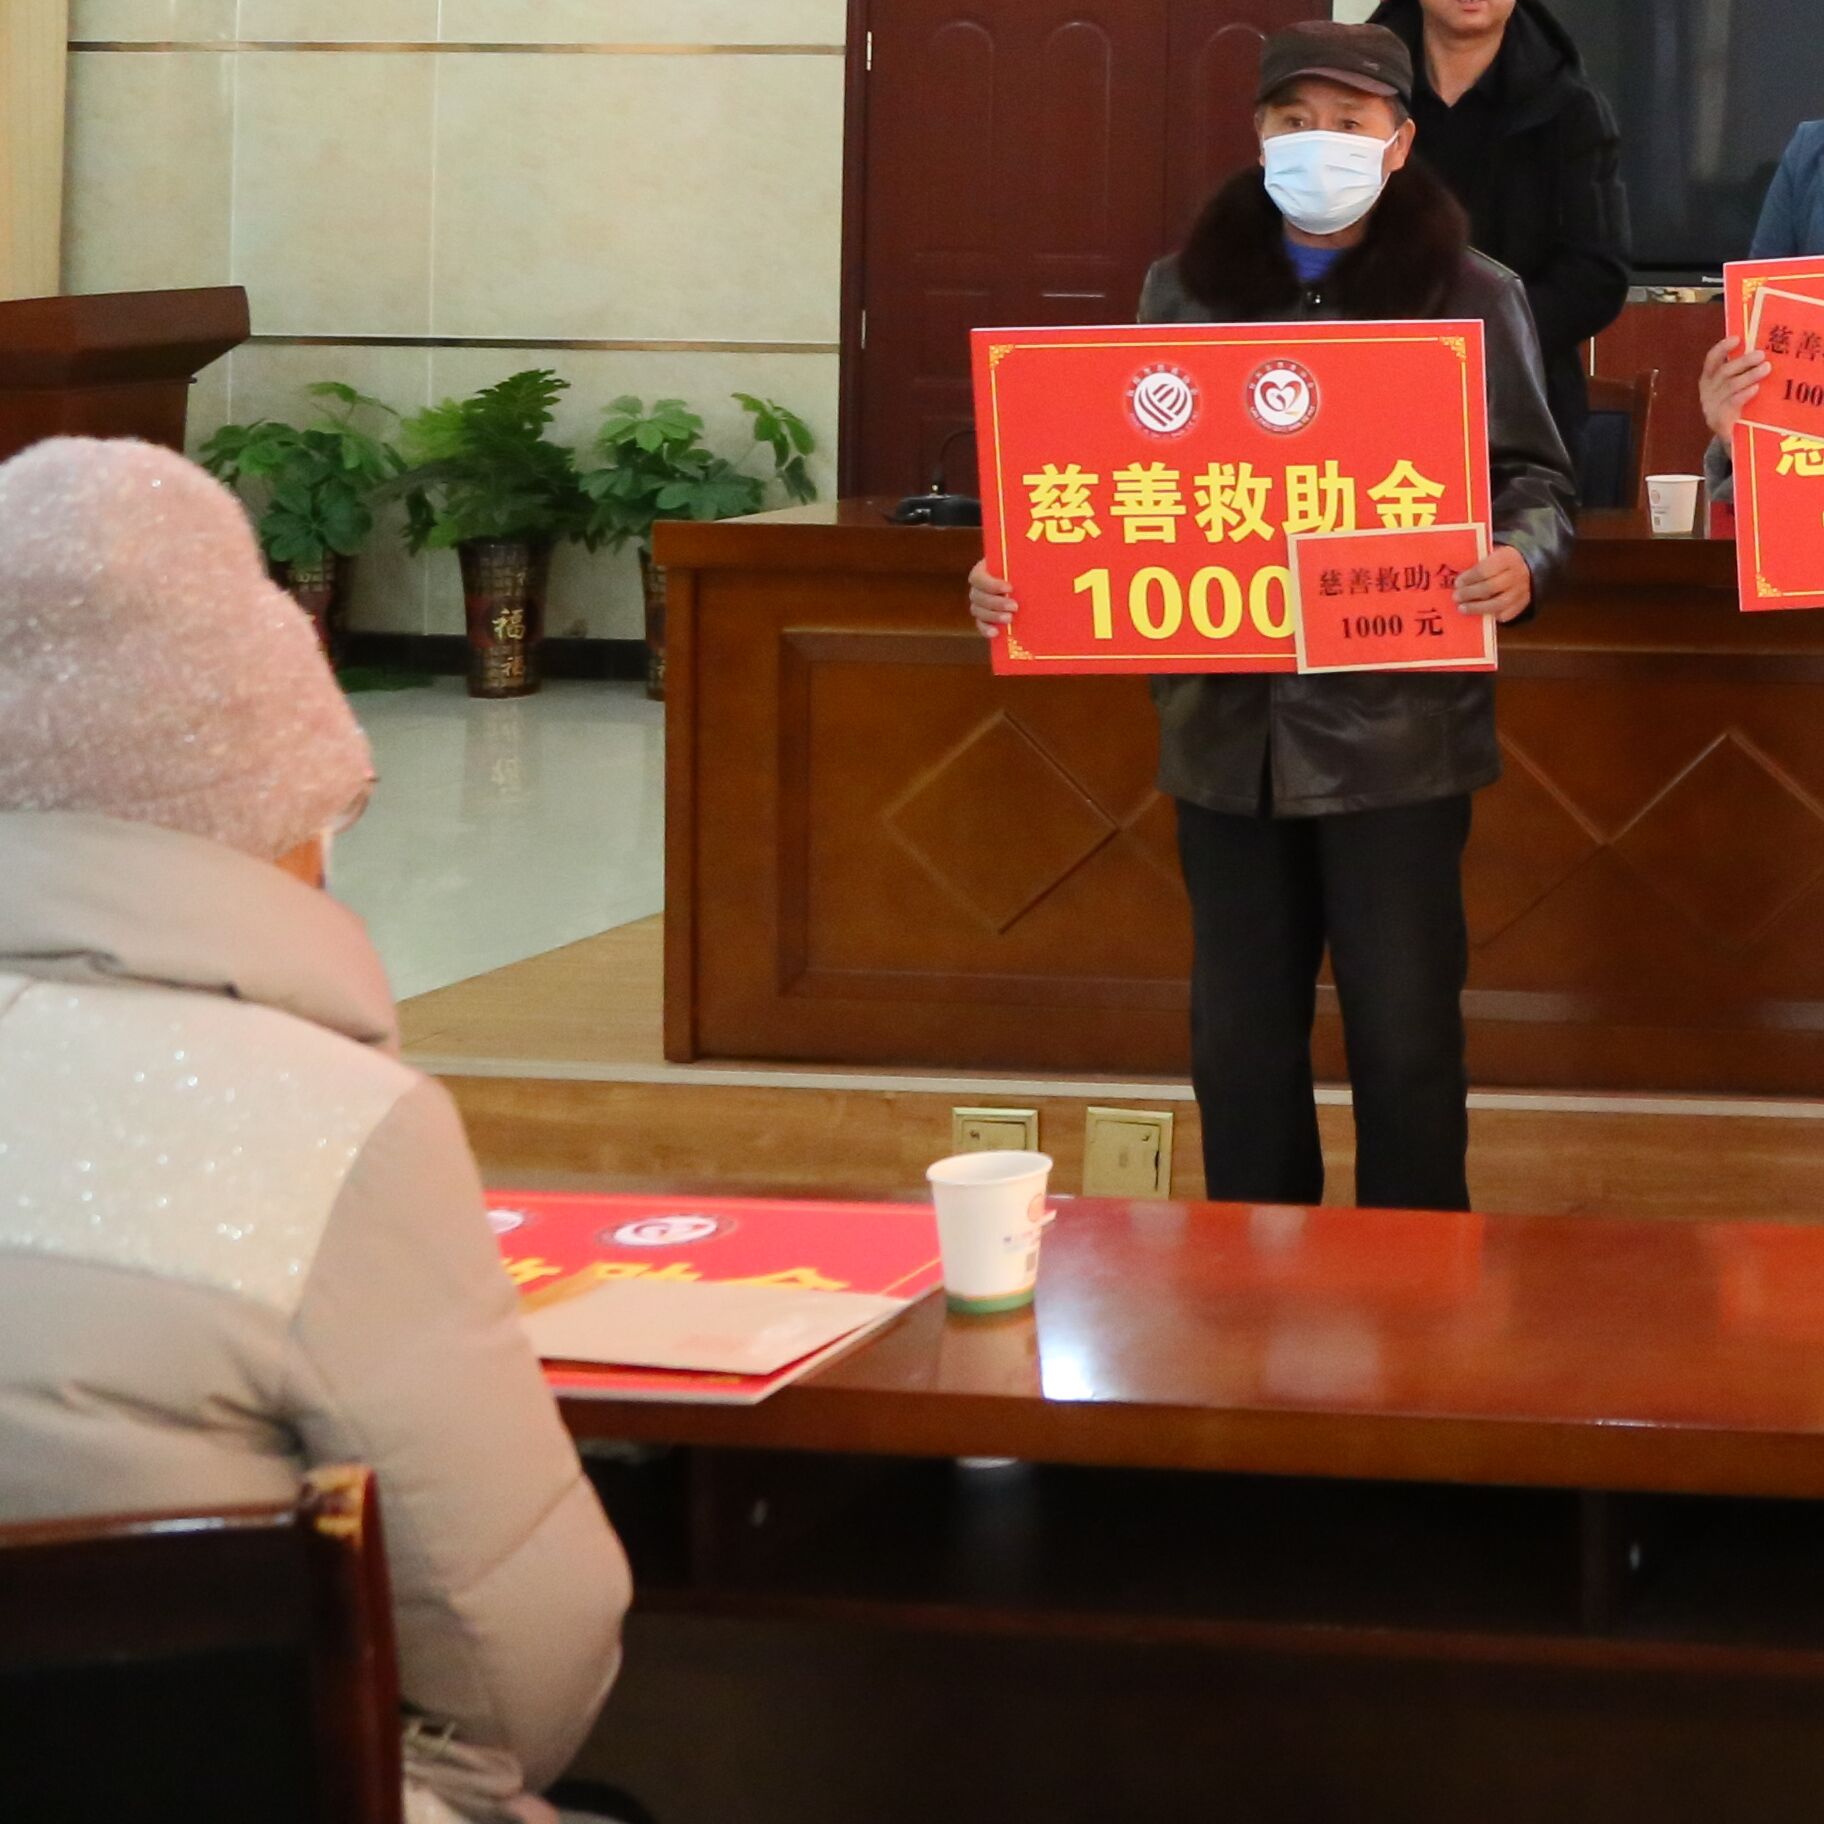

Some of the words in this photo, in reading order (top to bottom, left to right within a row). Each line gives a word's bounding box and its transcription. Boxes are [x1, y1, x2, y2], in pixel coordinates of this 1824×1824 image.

[1022, 459, 1446, 544] 慈善救助金
[1319, 563, 1459, 597] 慈善救助金
[1342, 614, 1403, 639] 1000
[1414, 608, 1444, 637] 元
